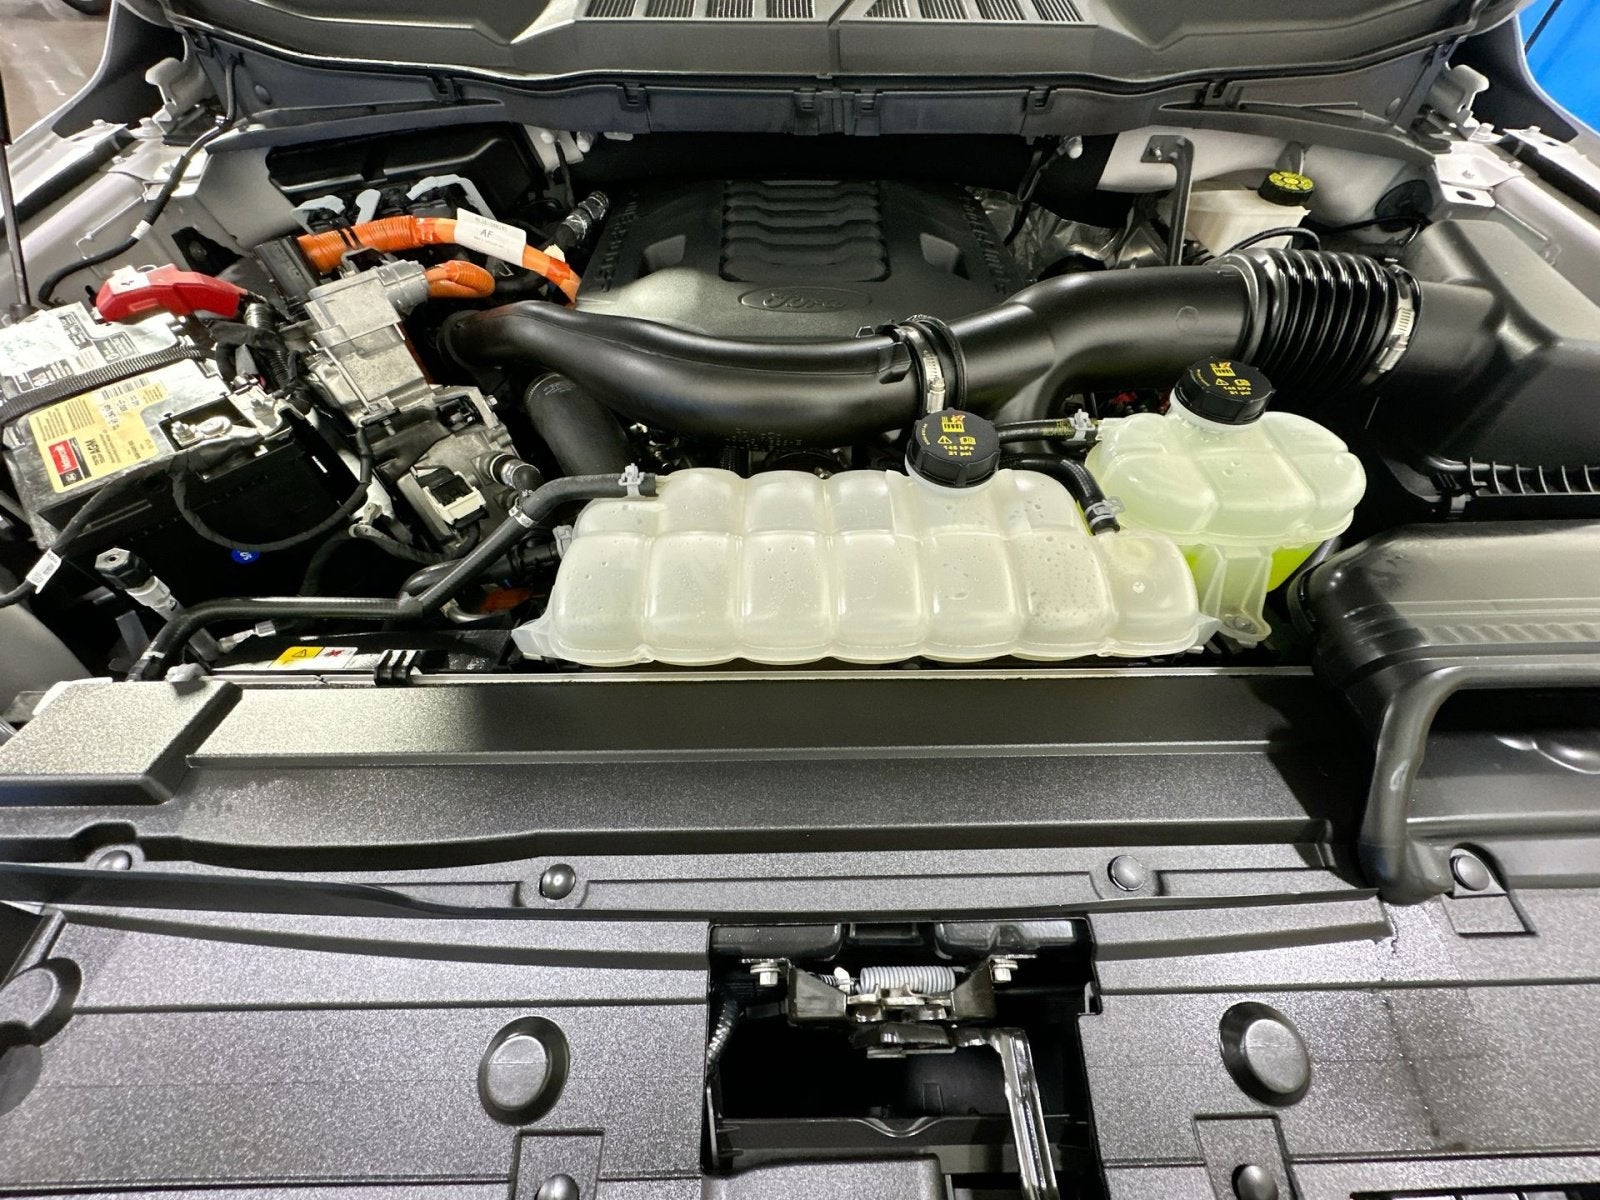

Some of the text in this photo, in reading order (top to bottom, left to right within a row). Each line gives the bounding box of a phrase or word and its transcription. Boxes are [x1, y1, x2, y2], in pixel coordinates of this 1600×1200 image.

[480, 229, 494, 238] AF
[762, 292, 848, 310] Ford
[85, 438, 98, 455] AGM
